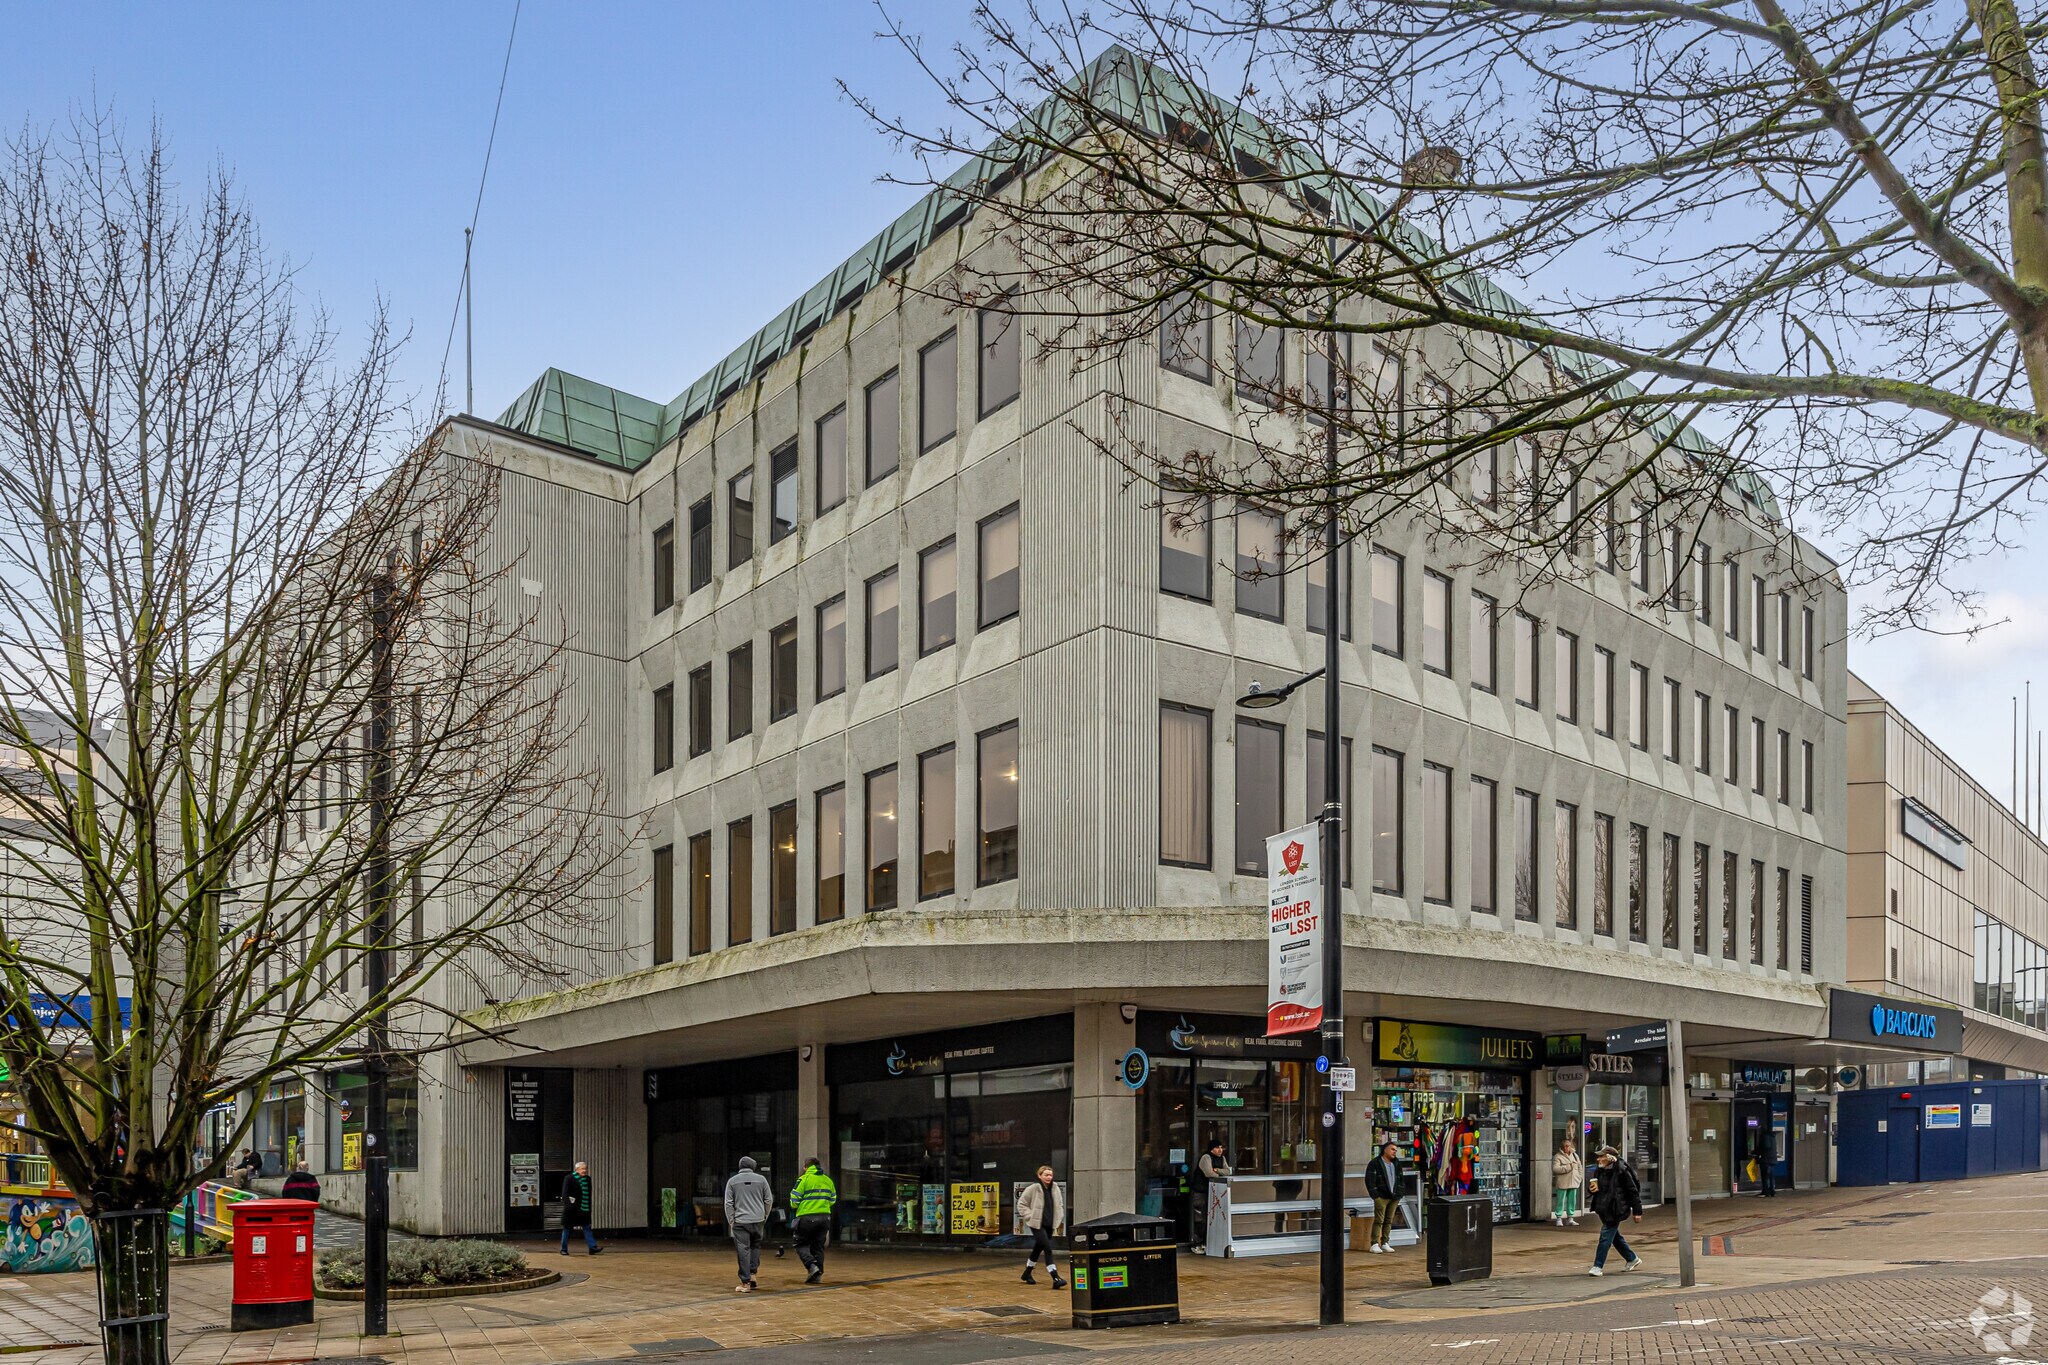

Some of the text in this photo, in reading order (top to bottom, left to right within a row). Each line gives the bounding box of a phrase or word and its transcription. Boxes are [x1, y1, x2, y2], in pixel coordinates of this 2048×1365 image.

[1288, 859, 1298, 868] LSST
[1276, 885, 1291, 893] SCIENCE
[1295, 877, 1317, 887] TECHNOLOGY
[1279, 879, 1294, 887] LONDON
[1274, 896, 1287, 906] THINK
[1271, 900, 1311, 923] HIGHER
[1274, 915, 1318, 935] THINK LSST
[1886, 1008, 1937, 1039] BARCLAYS
[1244, 1037, 1255, 1045] REAL
[1267, 1038, 1287, 1047] AWESOME
[1287, 1039, 1302, 1047] COFFEE
[944, 1051, 953, 1059] REAL
[963, 1047, 981, 1056] AWESOME
[980, 1046, 995, 1055] COFFEE
[1481, 1037, 1534, 1061] JULIETS
[1547, 1044, 1582, 1057] JULIETS
[1589, 1053, 1634, 1073] STYLES
[1558, 1072, 1584, 1081] STYLES
[1753, 1068, 1788, 1084] BARCLAYS
[1337, 1102, 1343, 1111] 6
[959, 1184, 996, 1194] BUBBLE TEA
[952, 1200, 976, 1211] £2.49
[952, 1219, 976, 1230] £3.49
